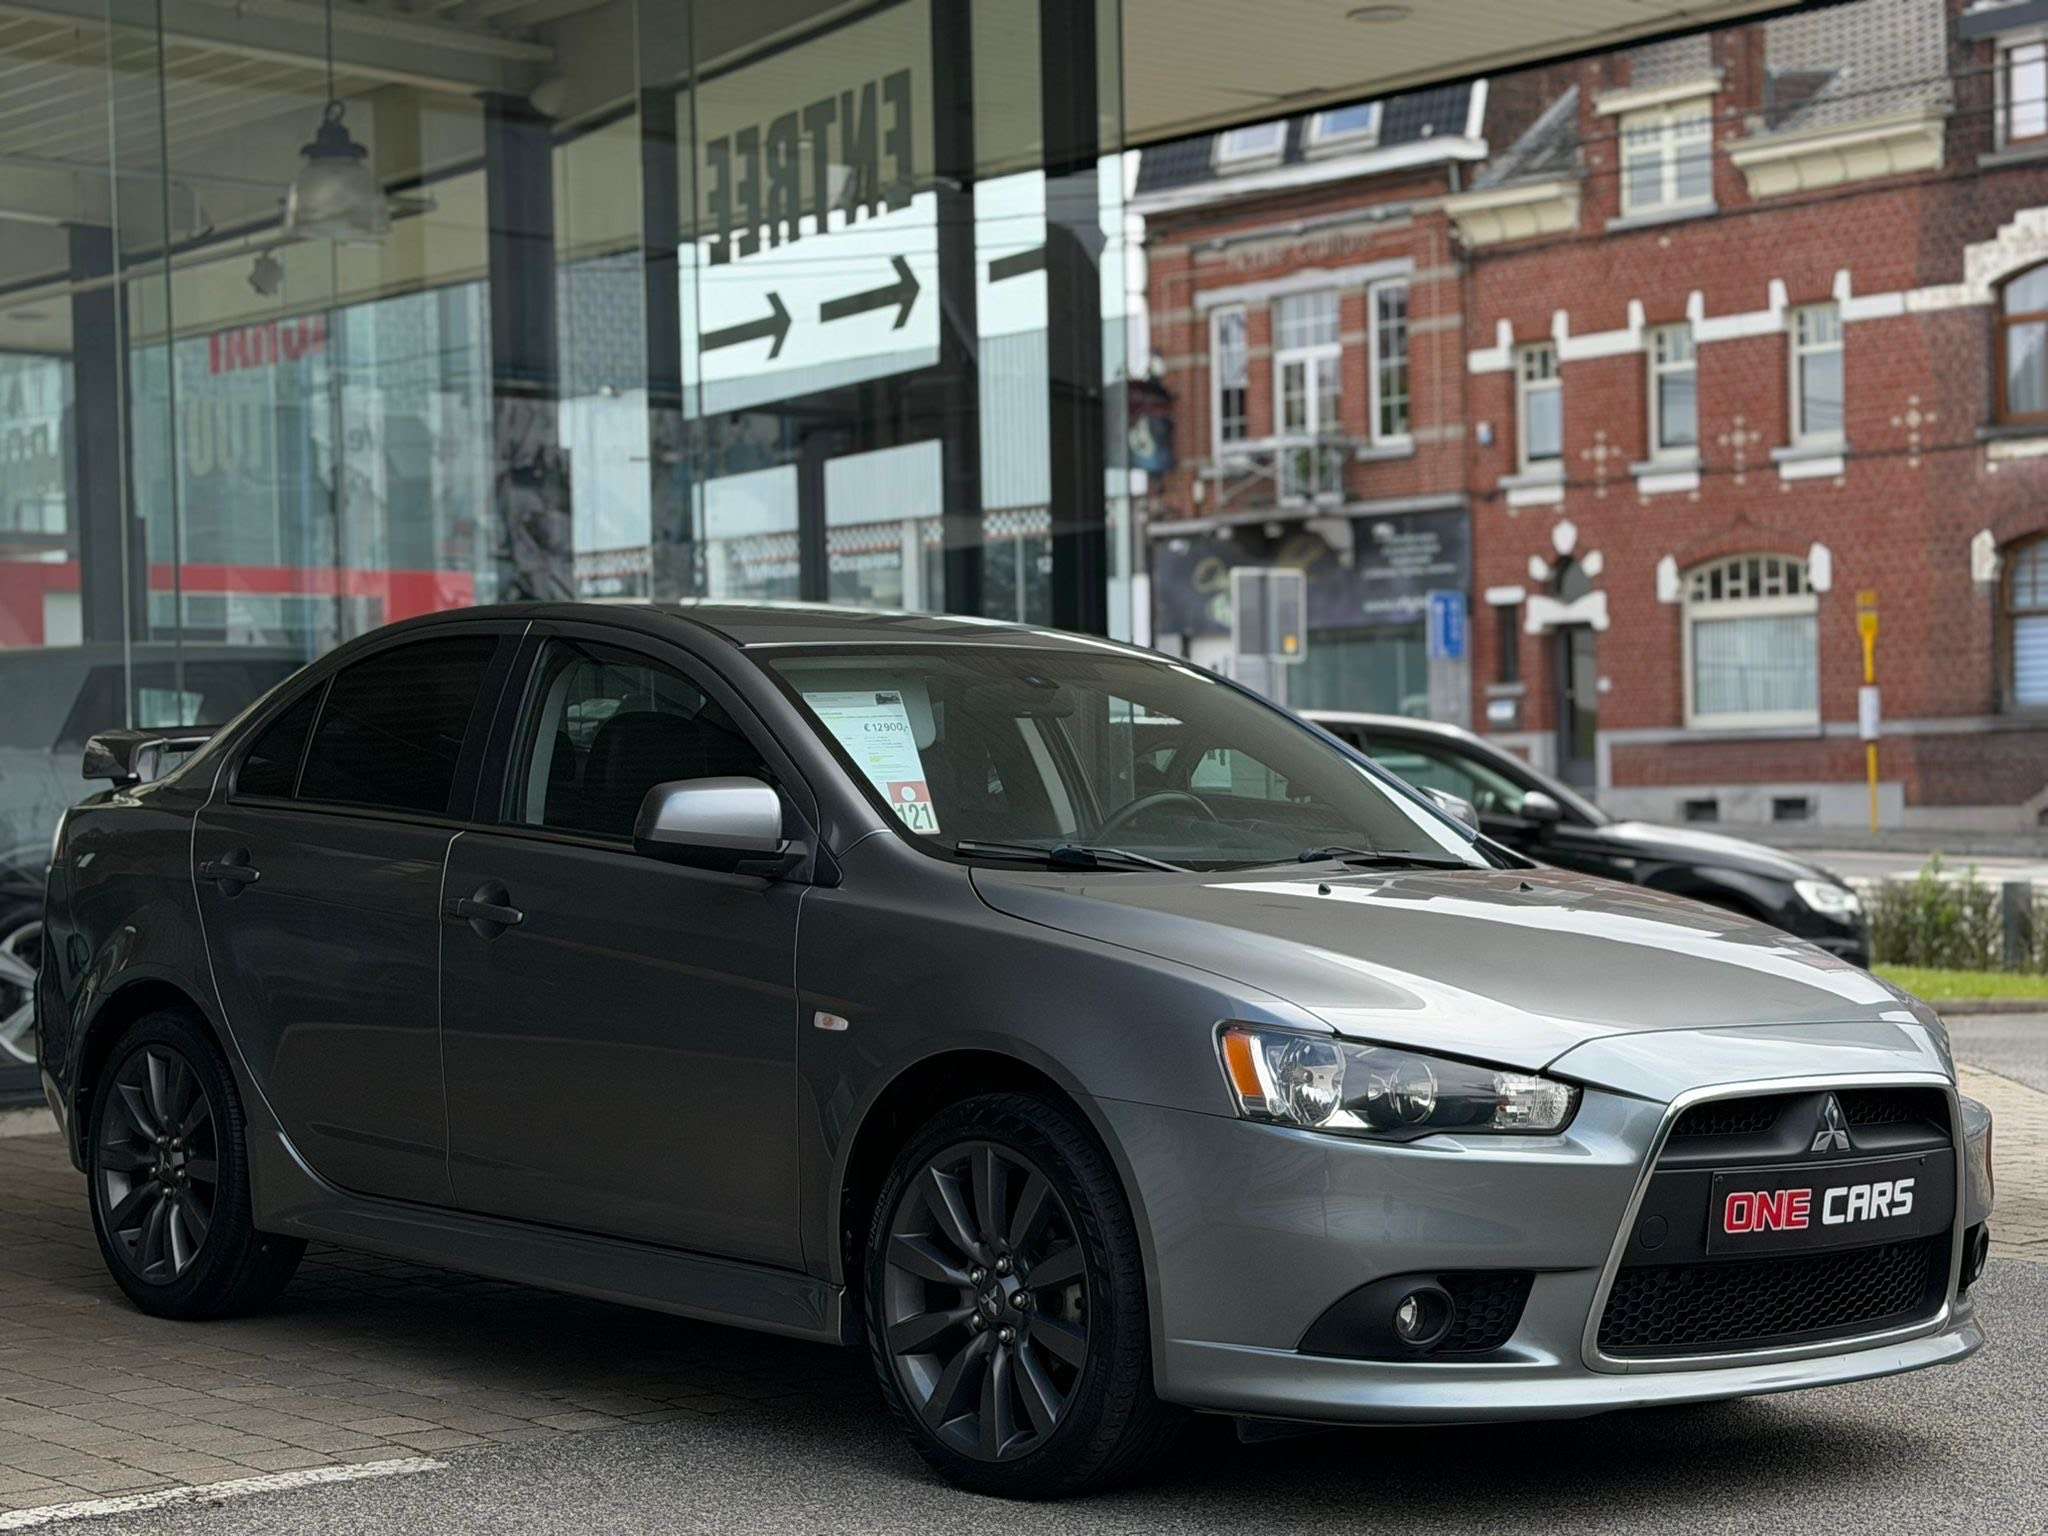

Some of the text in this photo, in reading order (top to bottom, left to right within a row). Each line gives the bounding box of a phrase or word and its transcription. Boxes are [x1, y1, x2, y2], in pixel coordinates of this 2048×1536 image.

[897, 803, 934, 829] 121
[1724, 1177, 1915, 1235] ONE CARS
